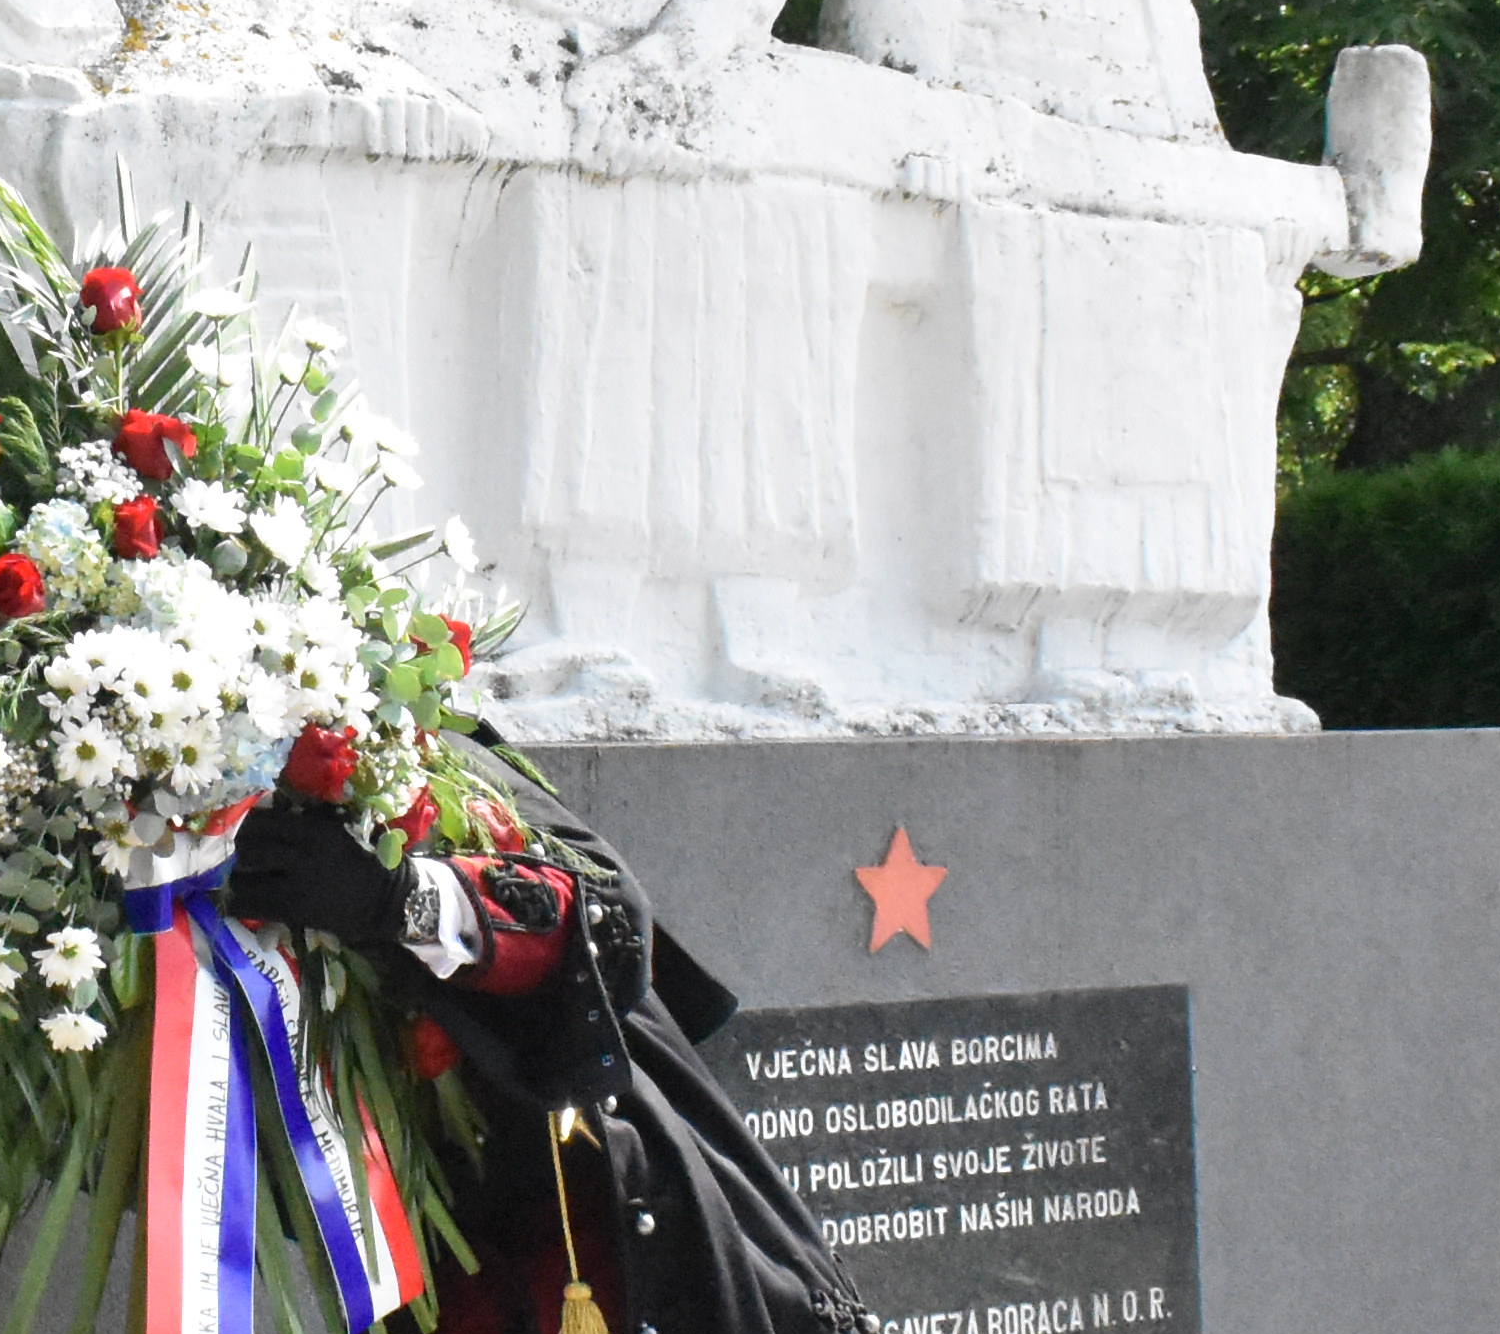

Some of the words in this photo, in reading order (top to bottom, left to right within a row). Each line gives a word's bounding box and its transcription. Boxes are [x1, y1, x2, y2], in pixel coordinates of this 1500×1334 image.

[746, 1039, 852, 1080] VJEČNA
[864, 1041, 940, 1072] SLAVA
[951, 1033, 1058, 1066] BORCIMA
[206, 1080, 227, 1142] HVALA
[826, 1082, 1039, 1133] OSLOBODILAČKOG
[1050, 1081, 1108, 1114] RATA
[197, 1154, 224, 1227] VJEČNA
[810, 1148, 923, 1192] POLOŽILI
[934, 1146, 1011, 1181] SVOJE
[1022, 1132, 1106, 1171] ŽIVOTE
[823, 1207, 948, 1247] DOBROBIT
[961, 1192, 1033, 1233] NAŠIH
[1044, 1186, 1140, 1222] NARODA
